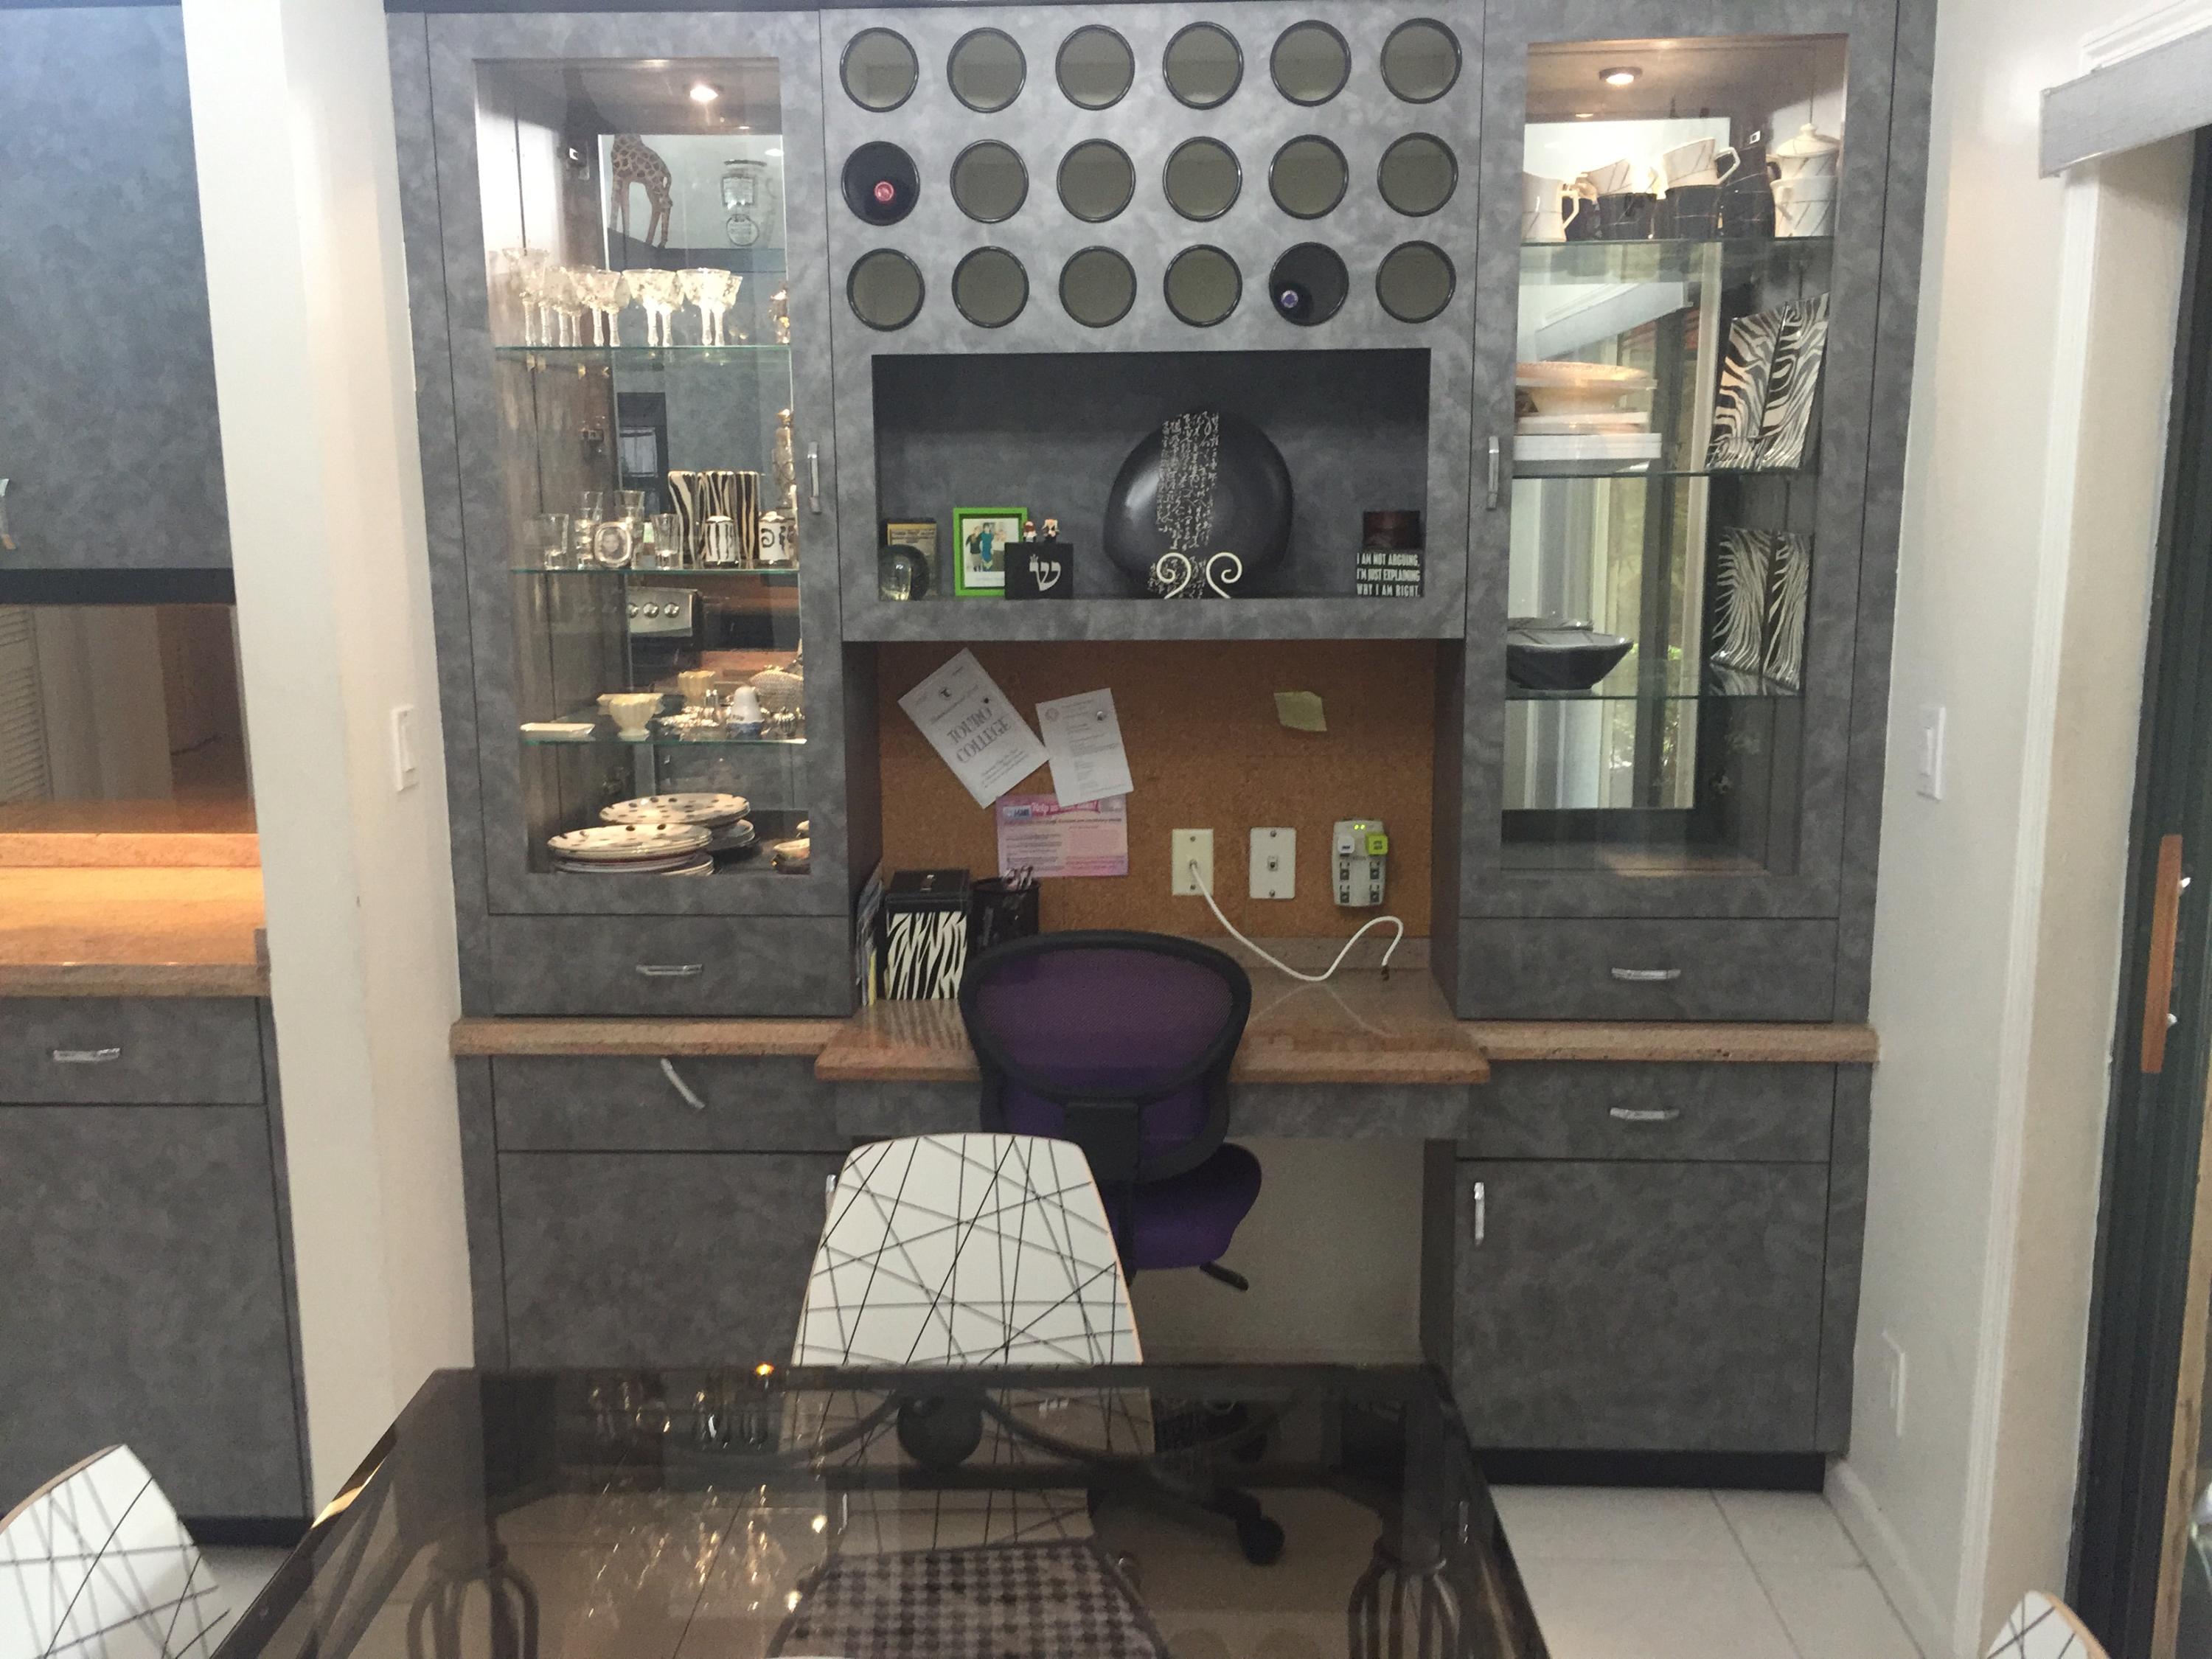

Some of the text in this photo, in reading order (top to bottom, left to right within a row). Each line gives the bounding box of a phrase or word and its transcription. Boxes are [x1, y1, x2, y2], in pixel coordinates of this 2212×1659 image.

[1361, 553, 1371, 565] AM
[1373, 553, 1386, 566] NOT
[1357, 568, 1420, 582] I'M JUST EXPLAINING
[1357, 583, 1372, 595] WHY
[1382, 584, 1393, 596] AM
[947, 706, 993, 745] TOURO
[956, 718, 1012, 764] COLLEGE
